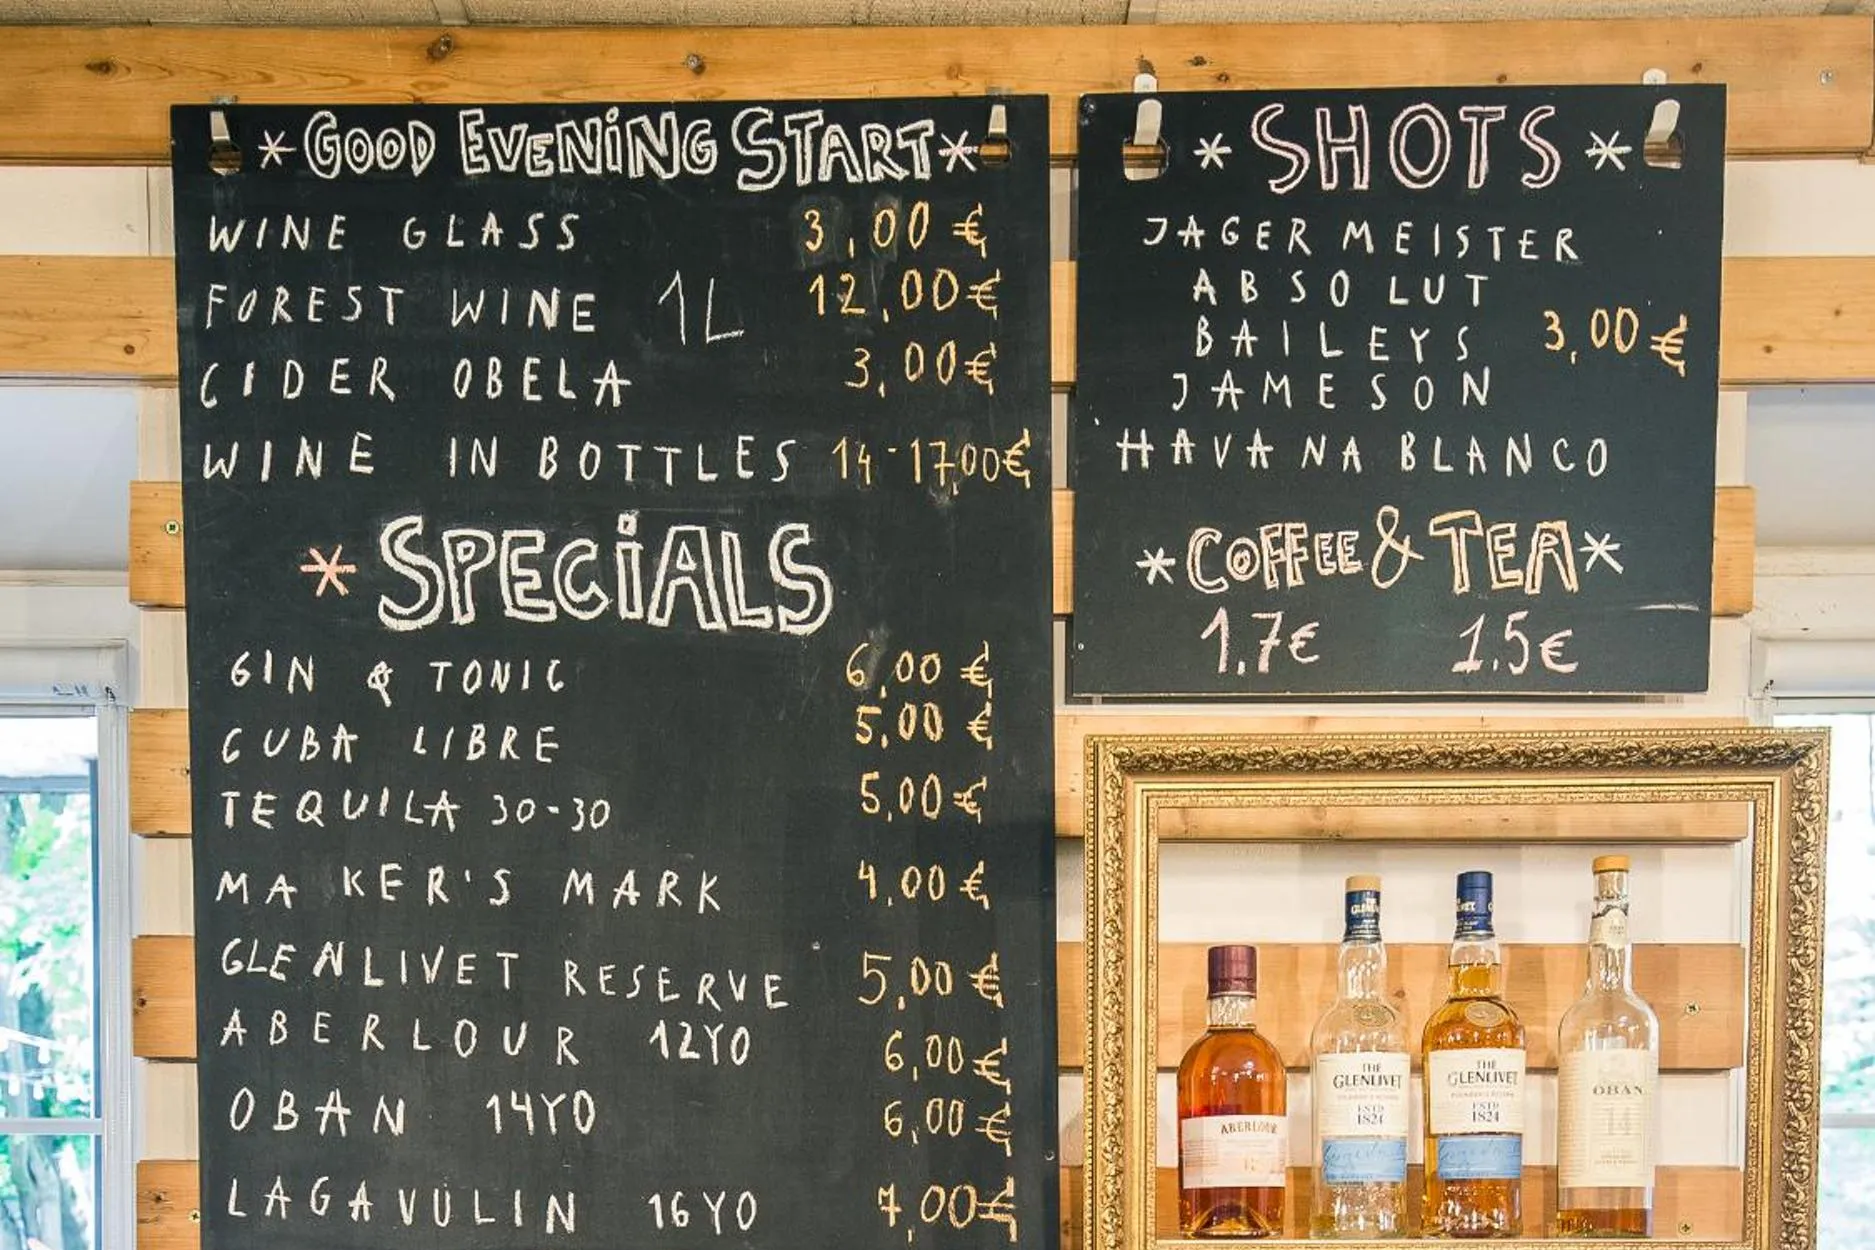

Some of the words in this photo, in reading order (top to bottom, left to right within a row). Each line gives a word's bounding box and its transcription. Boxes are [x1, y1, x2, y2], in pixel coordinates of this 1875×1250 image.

[305, 111, 435, 178] GOOD
[732, 106, 935, 191] START
[1250, 103, 1562, 194] SHOTS
[209, 214, 346, 252] WINE
[403, 212, 579, 250] GLASS
[206, 284, 404, 329] FOREST
[451, 288, 596, 332] WINE
[658, 269, 744, 345] 1L
[1193, 269, 1489, 306] ABSOLUT
[1195, 316, 1469, 362] BAILEYS
[201, 357, 396, 408] CIDER
[453, 357, 632, 407] OBELA
[1172, 367, 1492, 412] JAMESON
[203, 432, 374, 482] WINE
[449, 436, 498, 478] IN
[538, 435, 796, 487] BOTTLES
[1116, 428, 1362, 471] HAVANA
[1400, 431, 1610, 477] BLANCO
[1186, 521, 1362, 594] COFFEE
[1371, 504, 1425, 589] &
[1428, 509, 1579, 595] TEA
[231, 650, 314, 693] GIN
[367, 661, 393, 707] &
[429, 659, 566, 695] TONIC
[222, 723, 358, 763] CUBA
[413, 724, 559, 762] LIBRE
[221, 787, 460, 832] TEQUILA
[491, 794, 611, 832] 30-30
[563, 868, 721, 914] MARK
[221, 938, 519, 991] GLENLIVET
[564, 960, 789, 1011] RESERVE
[220, 1008, 579, 1066] ABERLOUR
[648, 1020, 751, 1066] 12YO
[229, 1087, 405, 1137] OBAN
[486, 1089, 596, 1136] 14YO
[1592, 1085, 1643, 1096] OBAN
[227, 1174, 576, 1234] LAGAVULIN
[648, 1191, 757, 1235] 16YO
